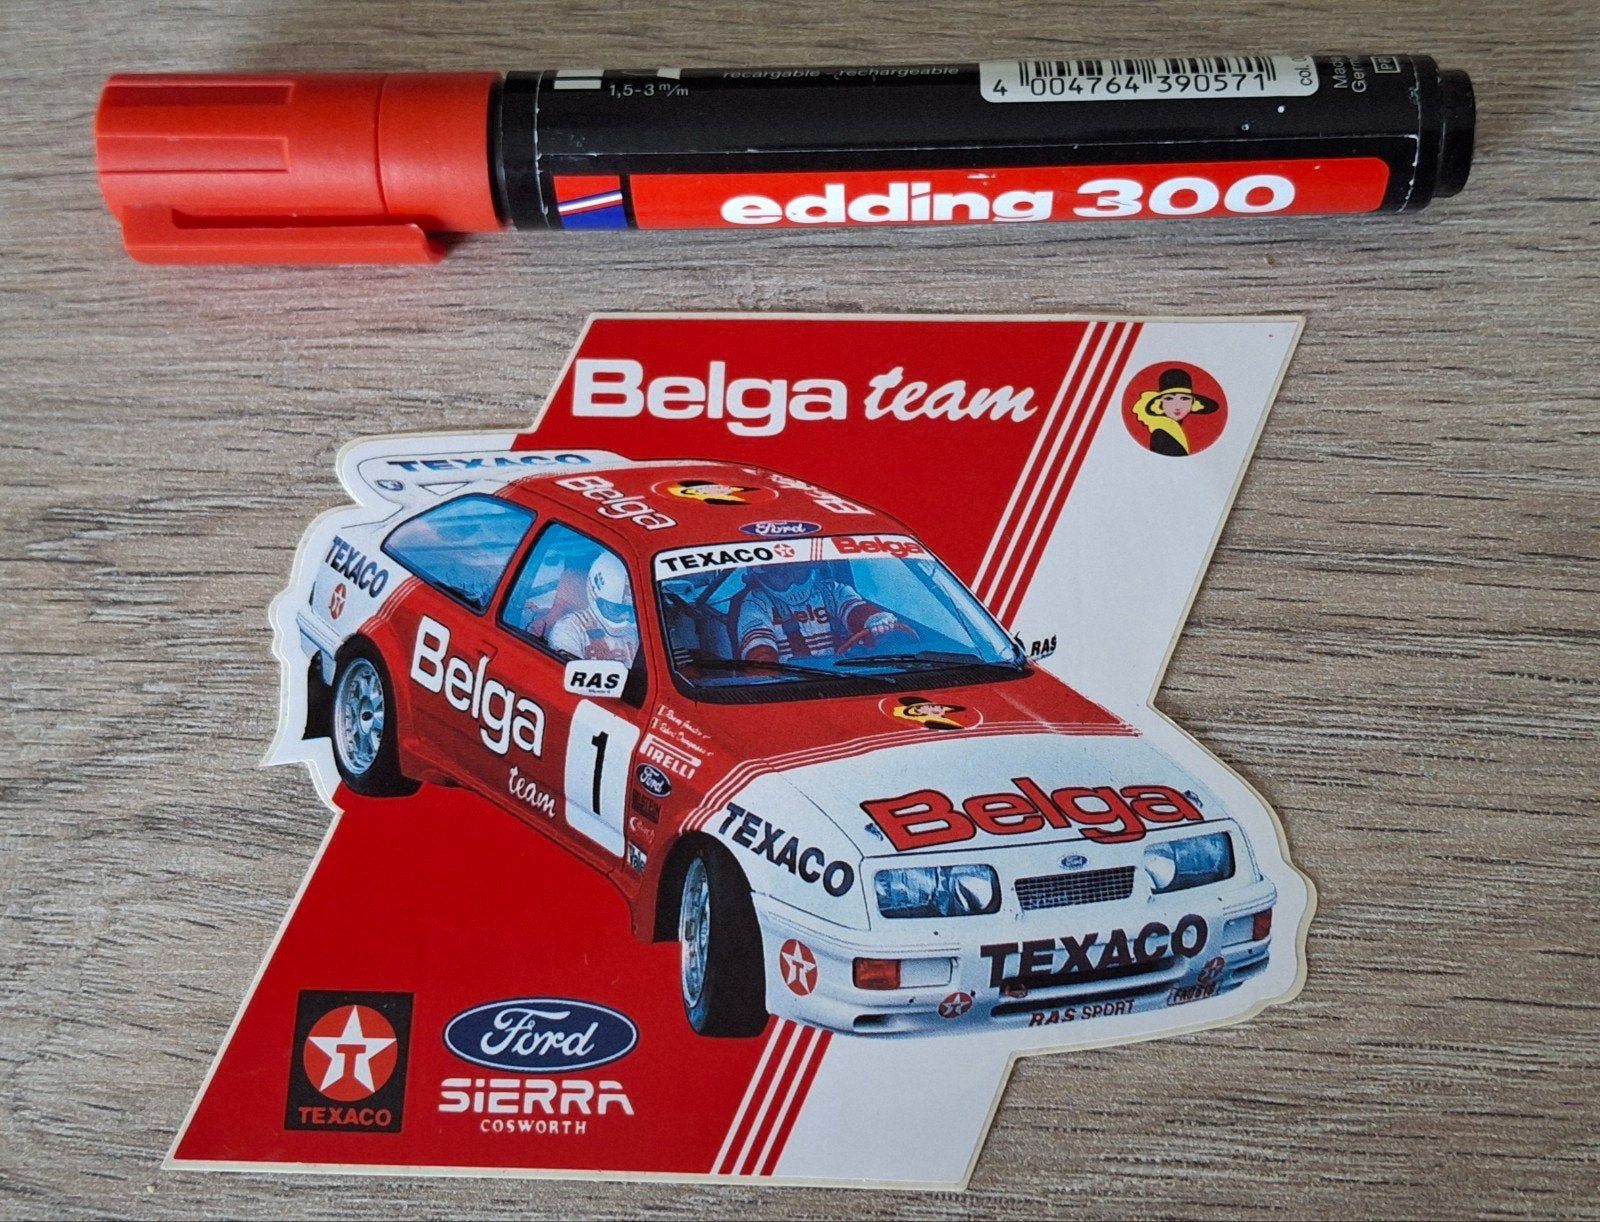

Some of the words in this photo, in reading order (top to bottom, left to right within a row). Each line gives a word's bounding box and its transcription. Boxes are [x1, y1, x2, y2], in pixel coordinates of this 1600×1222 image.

[838, 66, 960, 78] rechargeable
[992, 79, 1007, 96] 4
[1030, 74, 1140, 97] 004764
[1157, 73, 1265, 94] 390571
[609, 83, 655, 99] 1,5-3
[720, 182, 1054, 225] edding
[1072, 174, 1296, 218] 300
[572, 358, 848, 437] Belga
[864, 365, 1038, 422] team
[386, 453, 592, 473] TEXACO
[552, 475, 678, 531] Belga
[754, 520, 806, 535] Ford
[660, 546, 774, 573] TEXACO
[830, 536, 926, 559] Belga
[324, 534, 389, 598] TEXACO
[1030, 633, 1057, 657] RAS
[410, 614, 546, 759] Belga
[569, 671, 620, 689] RAS
[639, 732, 702, 780] PIRELLI
[590, 730, 609, 816] 1
[639, 766, 667, 795] Ford
[507, 765, 556, 819] team
[859, 777, 1204, 851] Belga
[717, 802, 855, 897] TEXACO
[980, 913, 1208, 989] TEXACO
[1028, 1007, 1076, 1027] RAS
[1080, 1000, 1136, 1020] SPORT
[479, 1007, 599, 1057] Ford
[298, 1105, 392, 1127] TEXACO
[480, 1119, 588, 1135] COSWORTH
